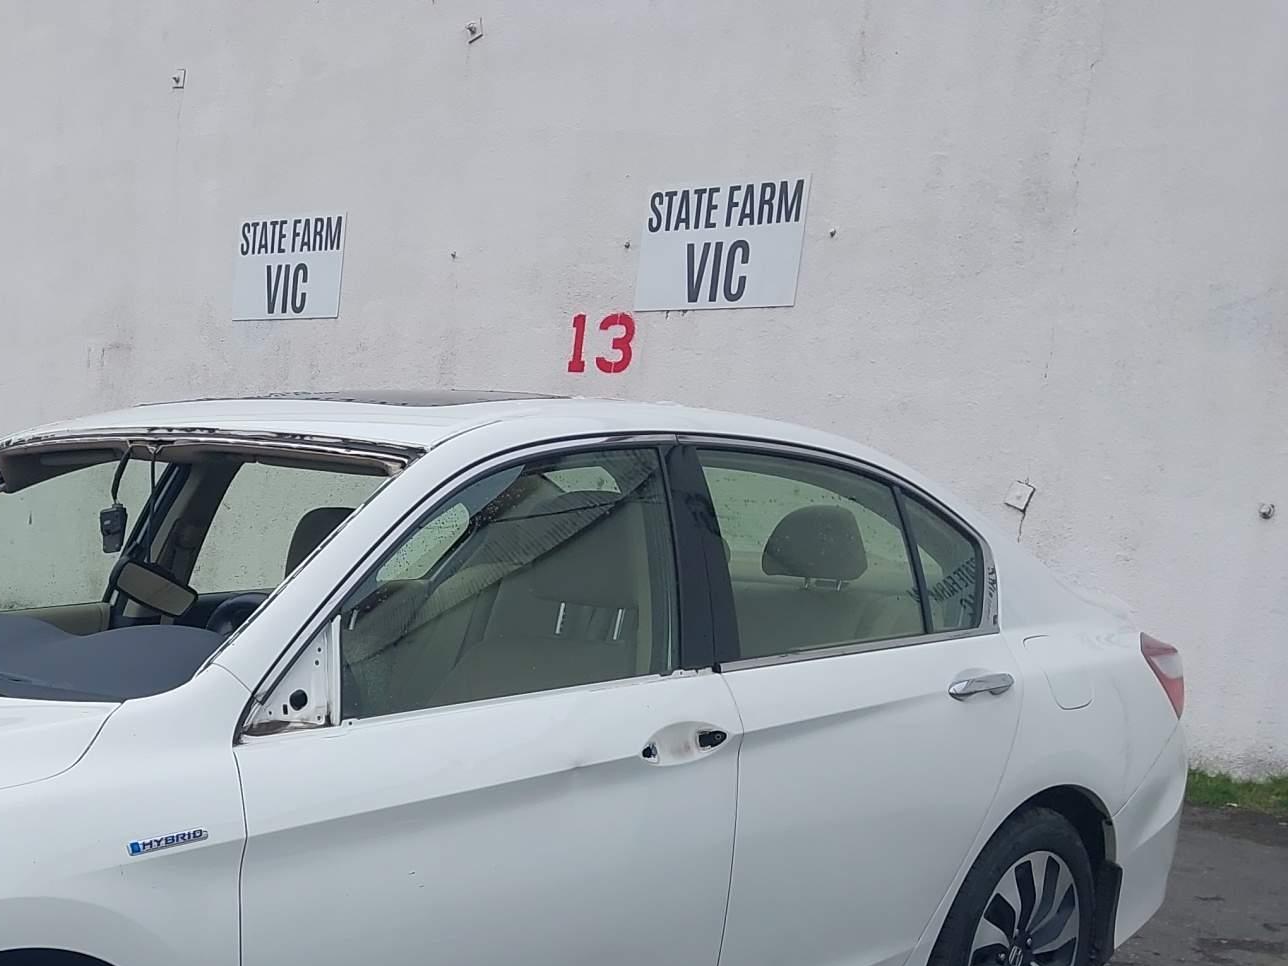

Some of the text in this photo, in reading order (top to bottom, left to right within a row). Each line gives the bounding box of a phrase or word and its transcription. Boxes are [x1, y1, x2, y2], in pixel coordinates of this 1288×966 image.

[648, 179, 805, 233] STATE FARM
[240, 216, 343, 256] STATE FARM
[266, 262, 308, 314] VIC
[686, 239, 750, 303] VIC
[567, 312, 636, 374] 13
[142, 829, 203, 850] HYBRID
